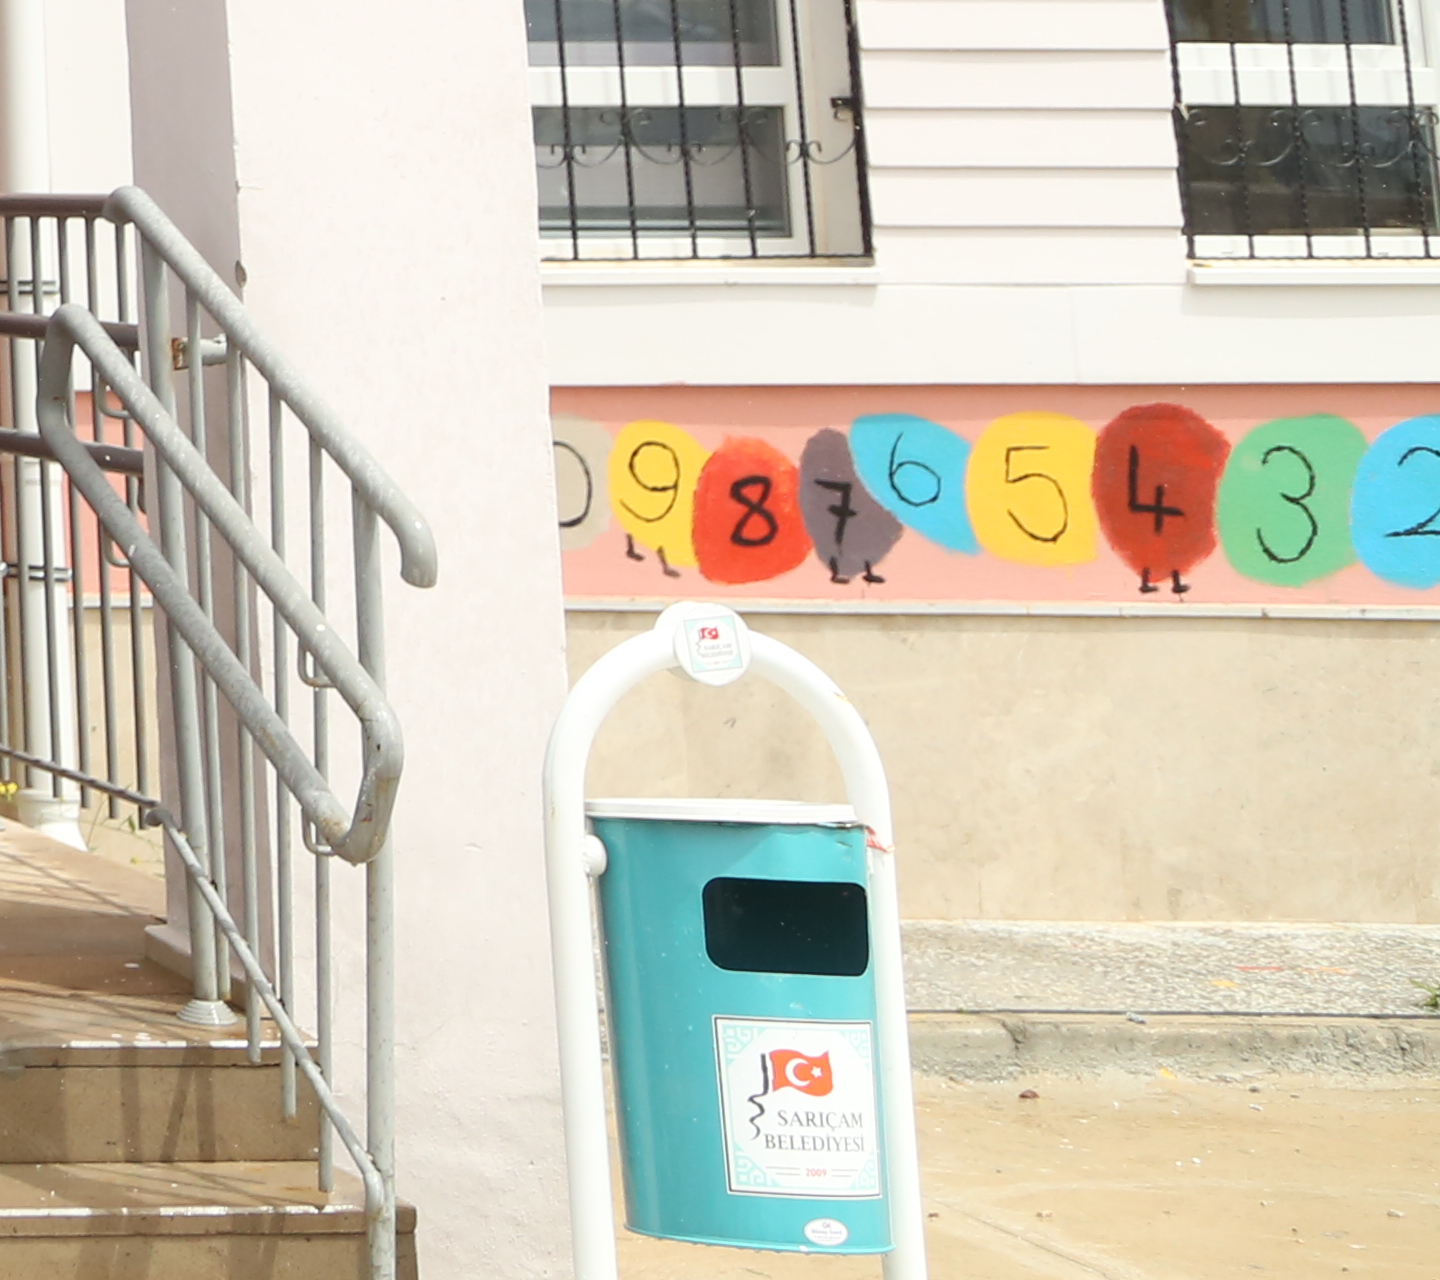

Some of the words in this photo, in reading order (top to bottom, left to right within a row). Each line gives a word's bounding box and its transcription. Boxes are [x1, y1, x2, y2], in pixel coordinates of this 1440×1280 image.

[620, 441, 681, 523] 9
[729, 474, 779, 548] 8
[813, 478, 858, 550] 7
[888, 432, 942, 507] 6
[1005, 446, 1069, 543] 5
[1127, 444, 1186, 535] 4
[1256, 445, 1319, 564] 3
[1384, 446, 1440, 537] 2
[776, 1108, 865, 1132] SARIÇAM
[763, 1132, 866, 1153] BELEDİYESİ
[805, 1168, 827, 1177] 2009
